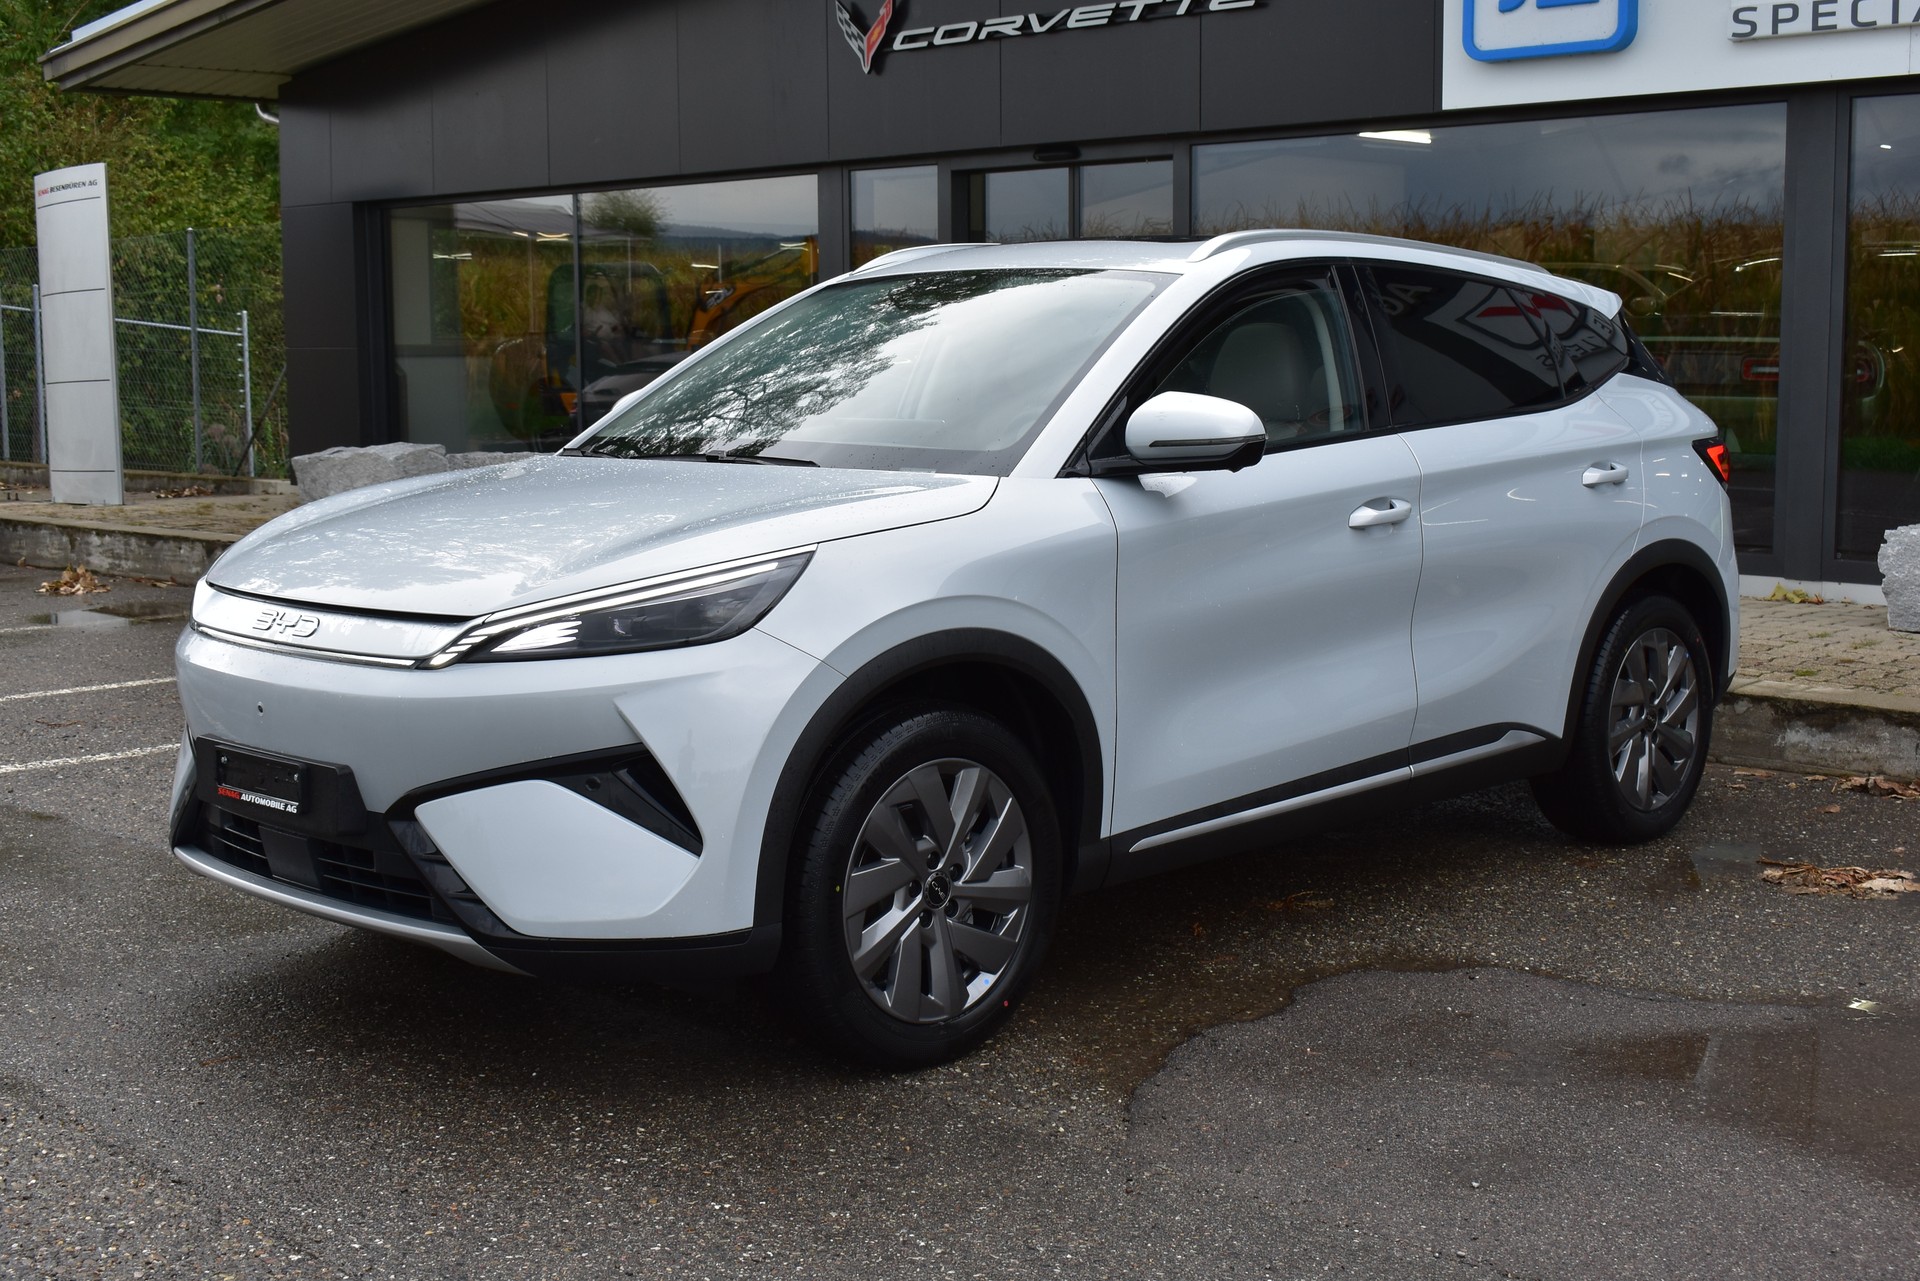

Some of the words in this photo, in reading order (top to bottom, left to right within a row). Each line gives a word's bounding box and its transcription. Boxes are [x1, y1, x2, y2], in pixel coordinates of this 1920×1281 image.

[87, 179, 98, 187] AG
[252, 608, 320, 638] BYD
[240, 793, 286, 811] AUTOMOBILE
[285, 804, 297, 813] AG
